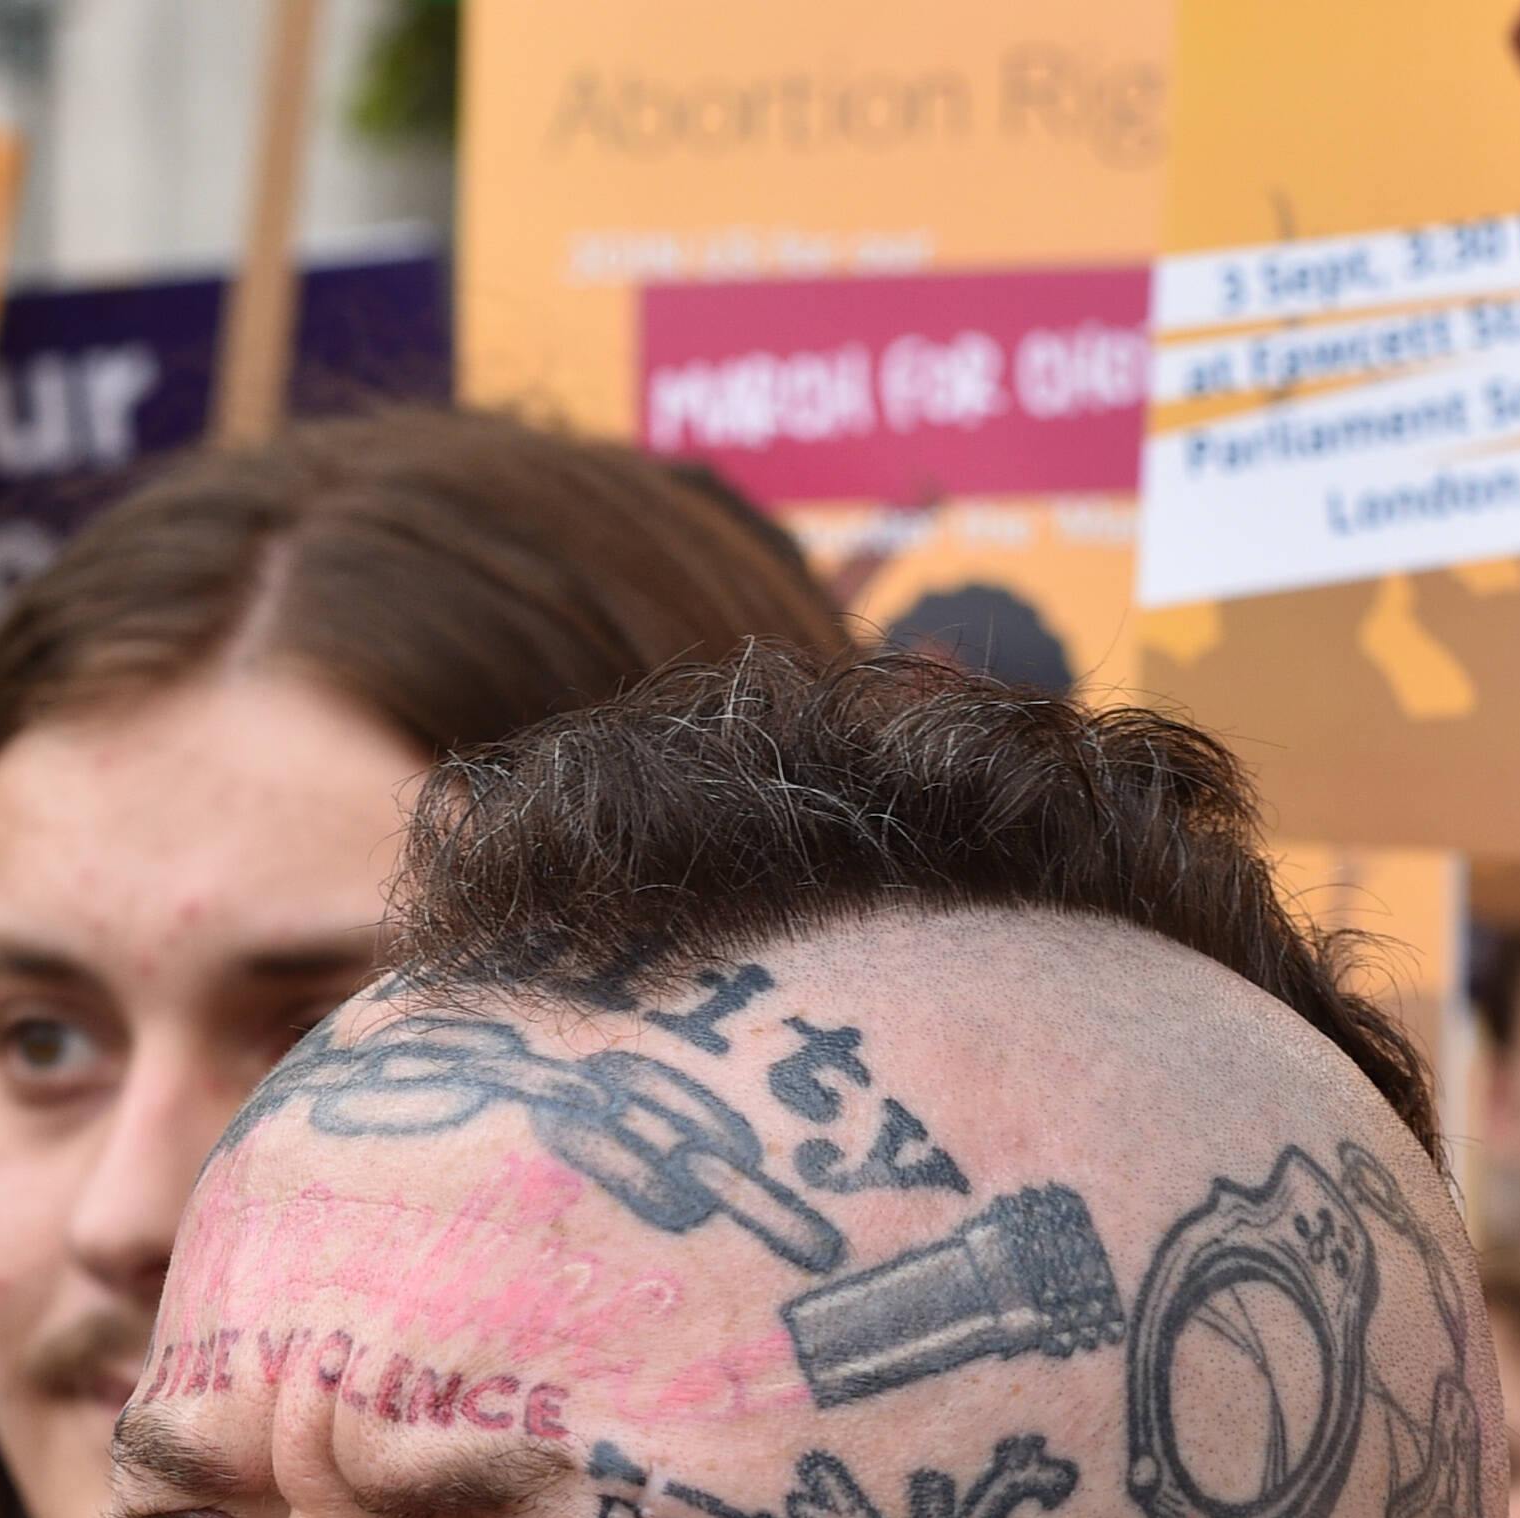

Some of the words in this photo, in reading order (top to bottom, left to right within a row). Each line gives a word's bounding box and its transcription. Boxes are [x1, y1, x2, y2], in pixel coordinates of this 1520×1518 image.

[547, 62, 966, 157] Abortion
[1002, 46, 1164, 166] Rig
[1216, 265, 1247, 311] 3
[1259, 247, 1388, 307] Sept,
[1020, 325, 1149, 415] CHO
[1186, 353, 1236, 400] at
[1252, 311, 1454, 384] Fawcett
[1185, 389, 1475, 476] Parliament
